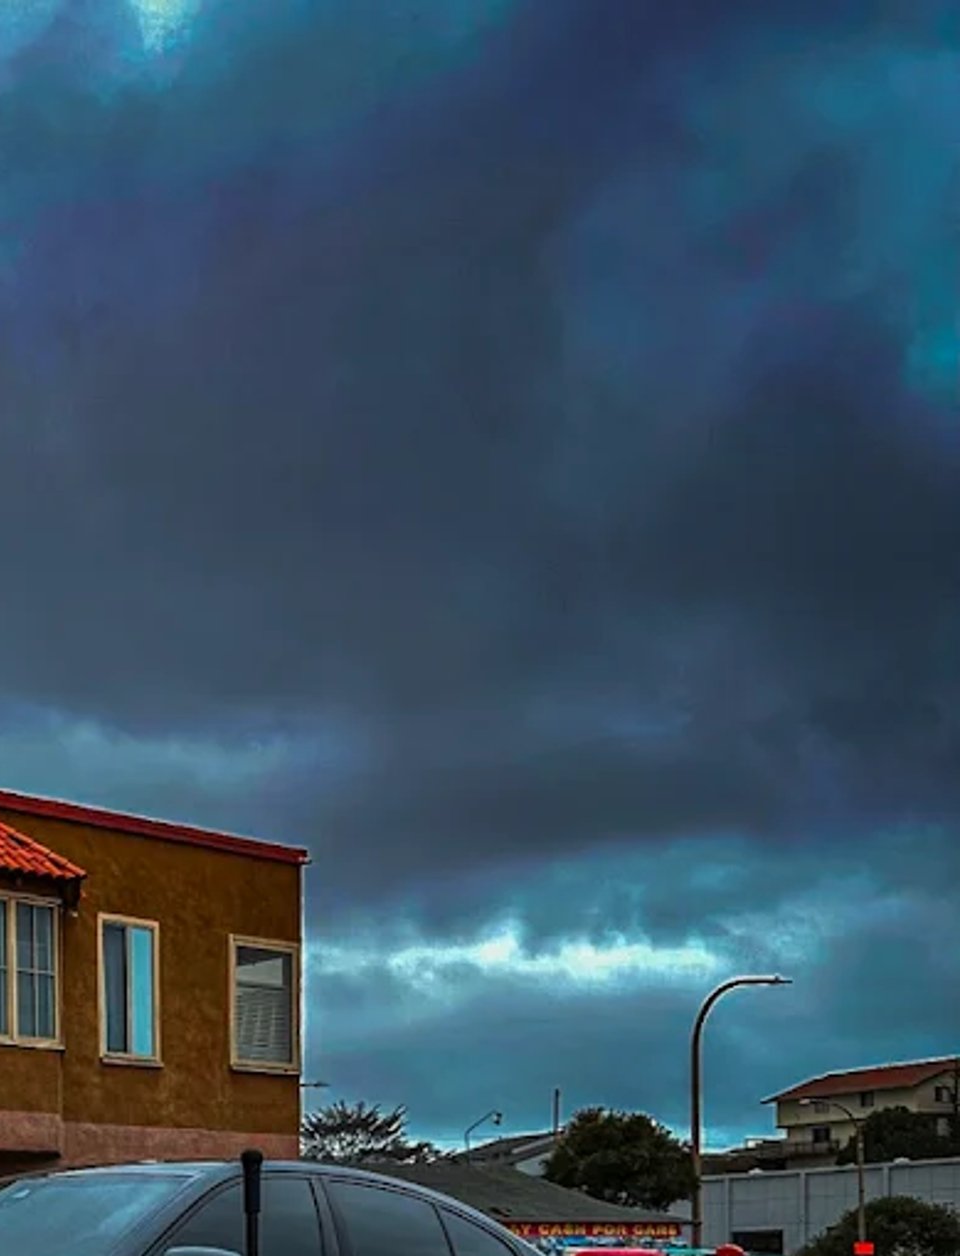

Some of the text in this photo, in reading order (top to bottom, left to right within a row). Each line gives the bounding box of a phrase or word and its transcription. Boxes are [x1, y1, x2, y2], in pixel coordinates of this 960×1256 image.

[539, 1223, 586, 1236] CASH
[592, 1223, 627, 1236] FOR
[633, 1223, 677, 1236] CARS
